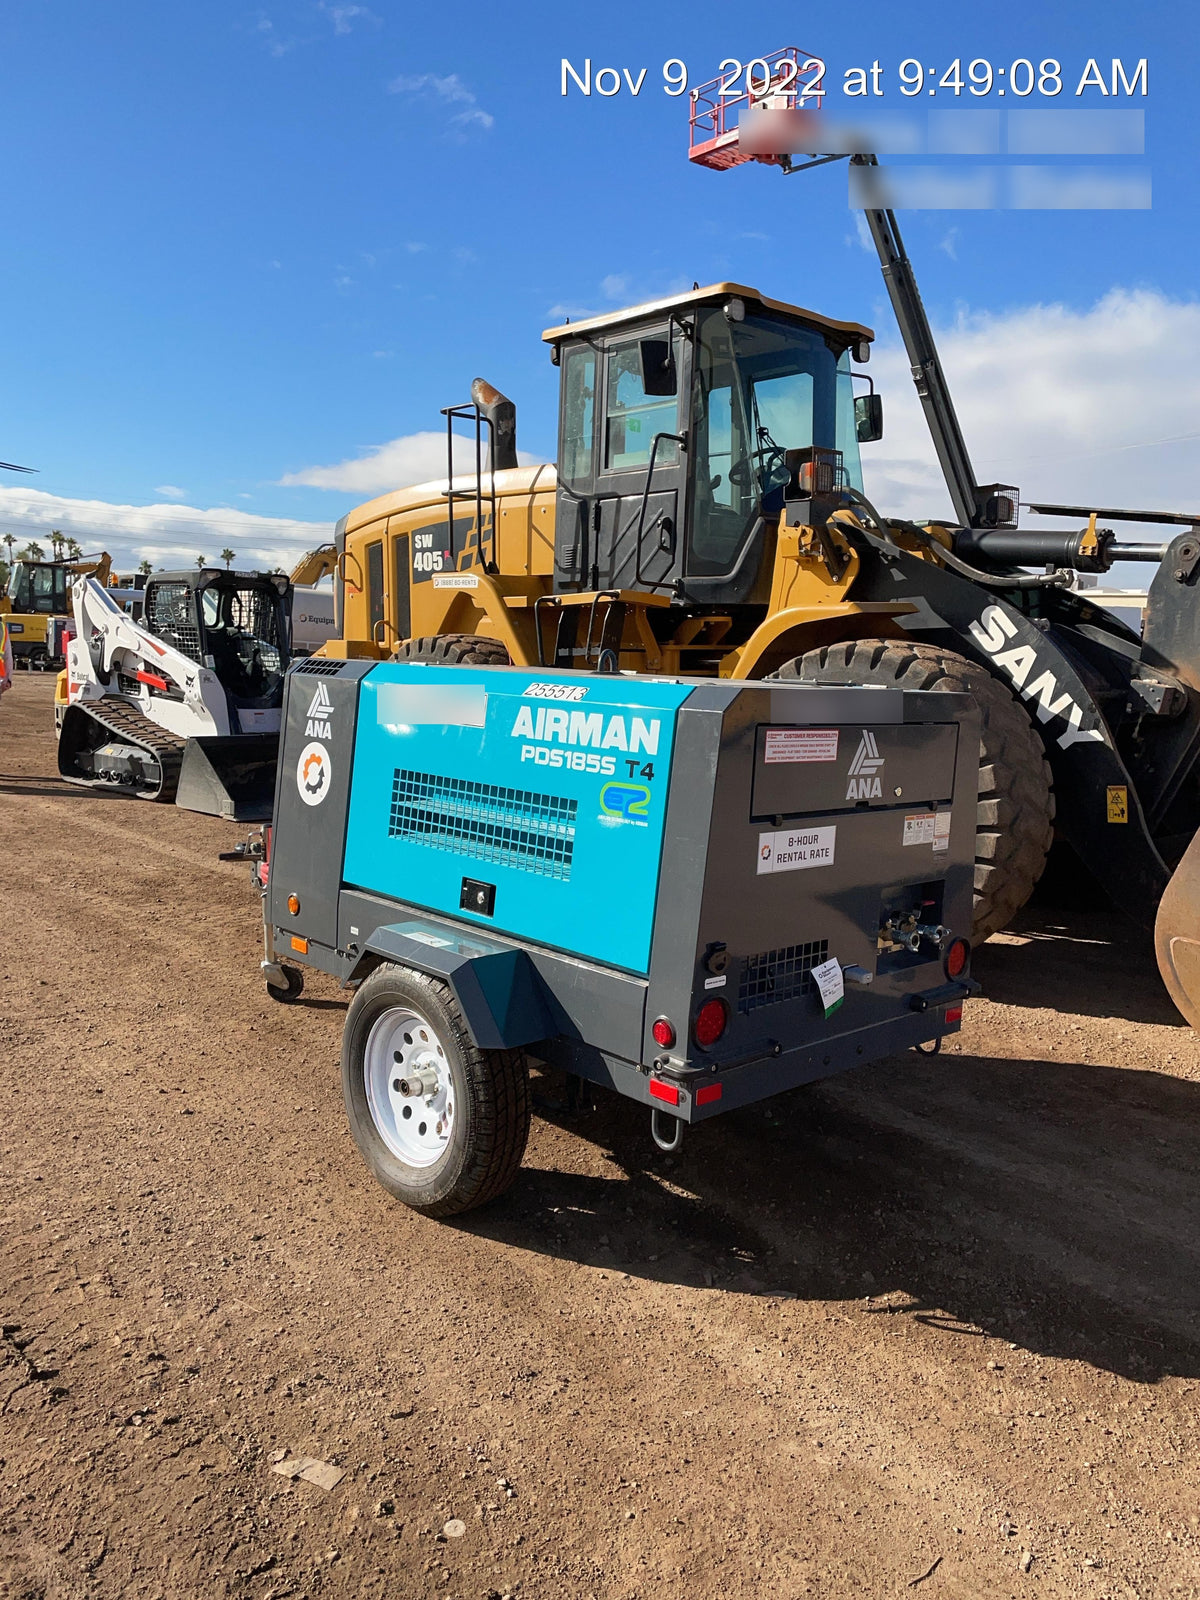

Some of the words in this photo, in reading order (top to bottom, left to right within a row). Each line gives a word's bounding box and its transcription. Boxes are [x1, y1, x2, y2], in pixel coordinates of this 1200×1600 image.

[414, 534, 433, 549] SW
[413, 551, 443, 572] 405
[967, 604, 1105, 751] SANY
[524, 683, 589, 701] 255513
[304, 719, 332, 740] ANA
[510, 705, 661, 756] AIRMAN
[520, 745, 617, 776] PDS185S
[625, 759, 655, 781] T4
[845, 776, 883, 801] ANA
[776, 851, 807, 864] RENTAL
[809, 847, 831, 860] RATE
